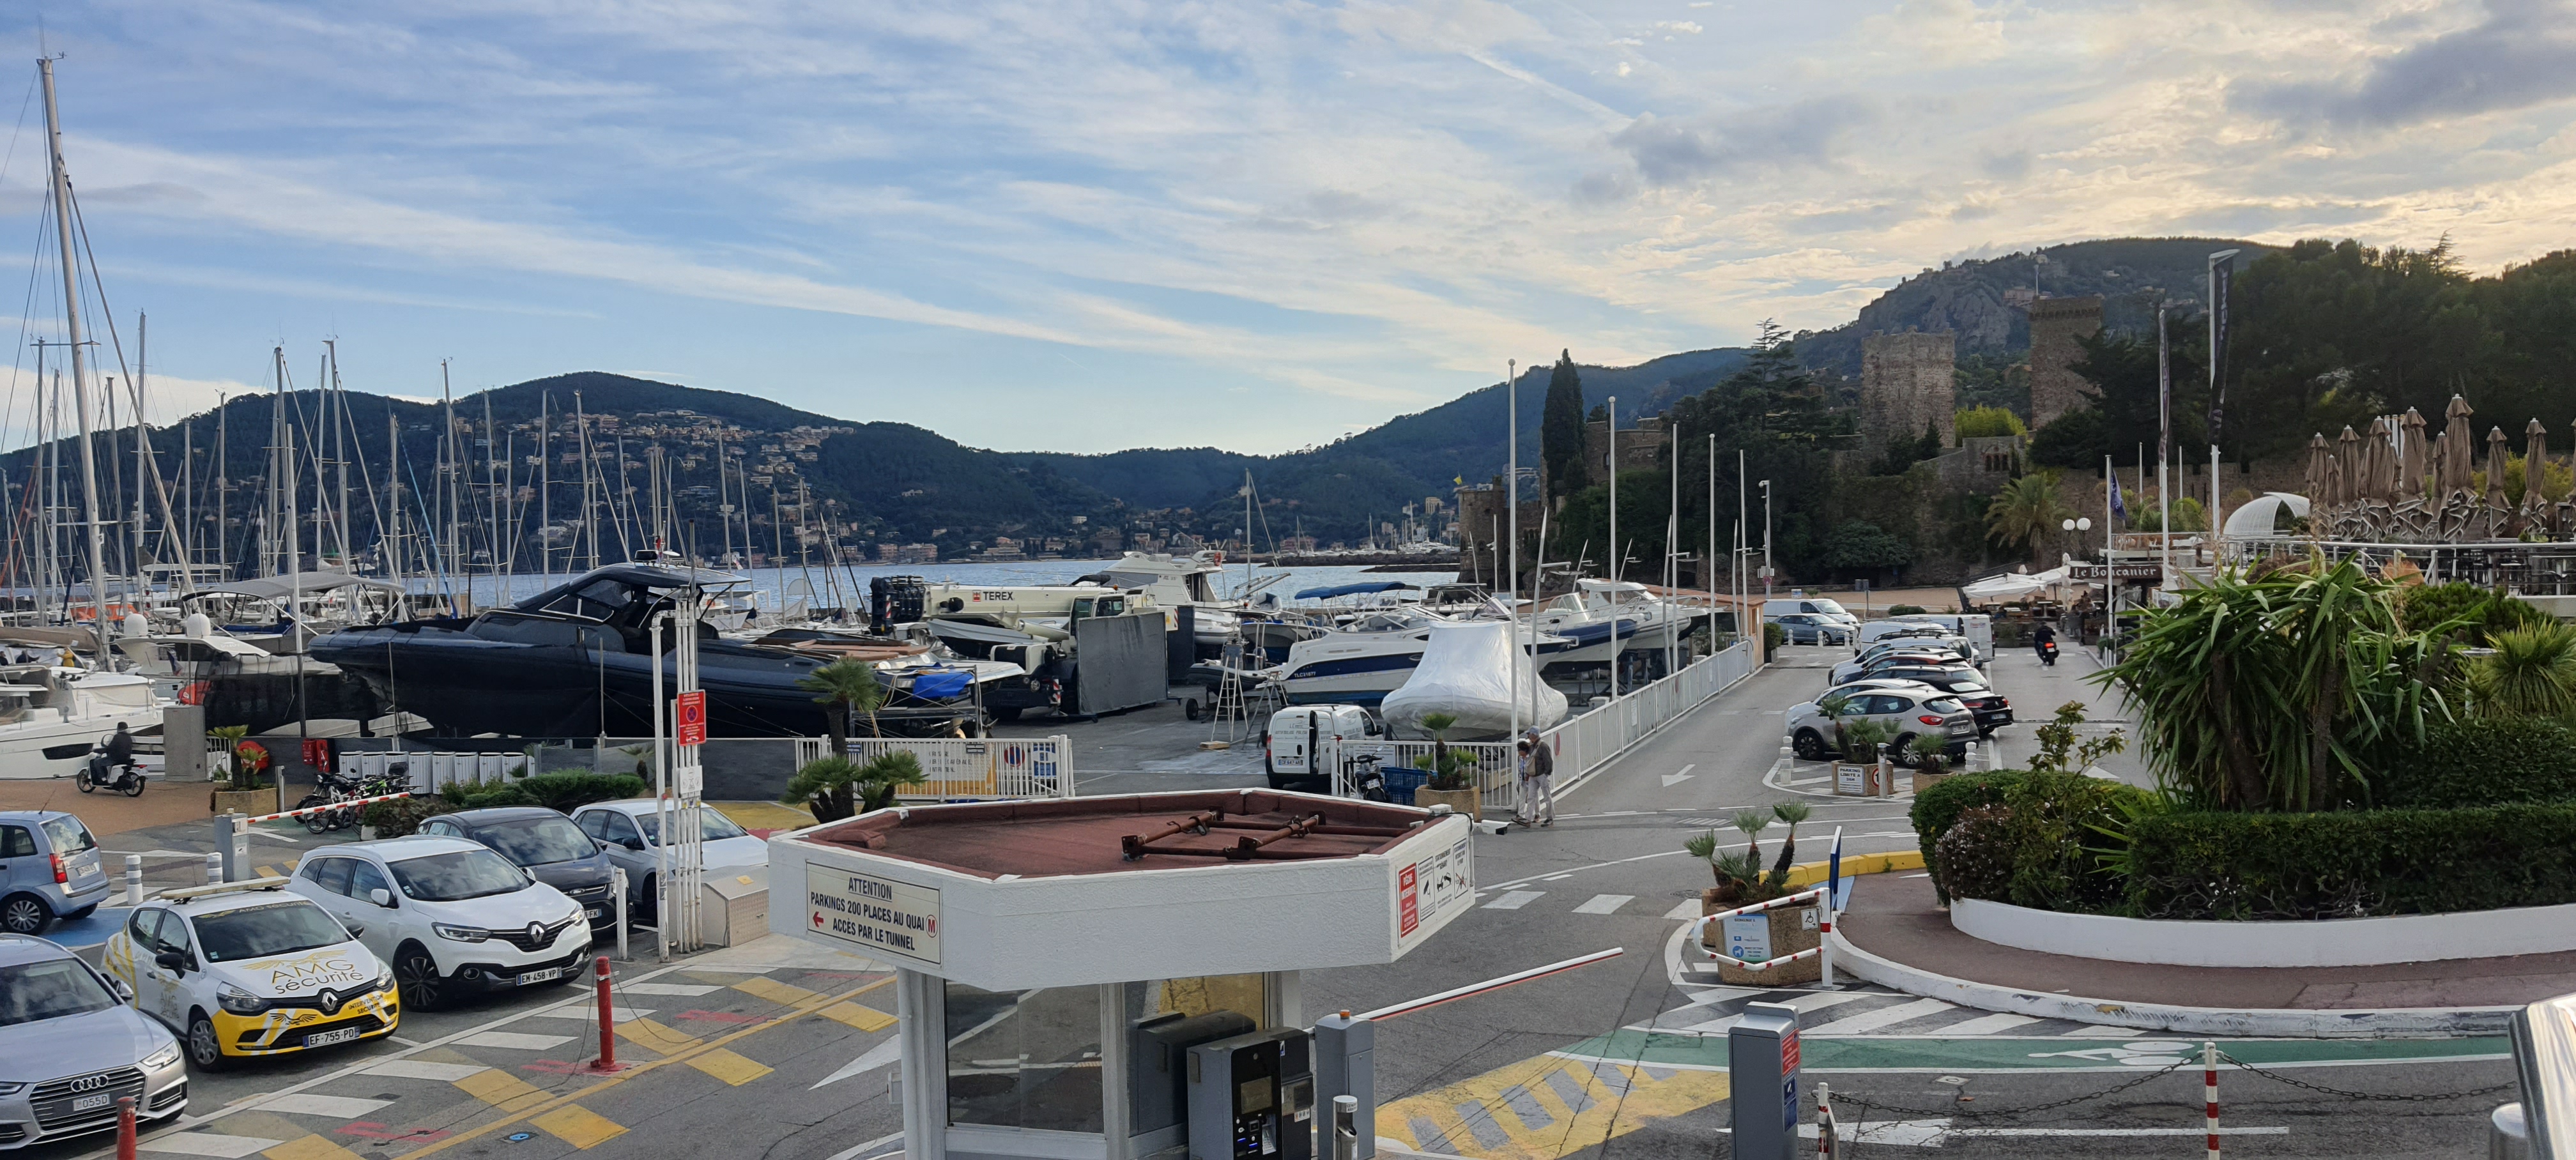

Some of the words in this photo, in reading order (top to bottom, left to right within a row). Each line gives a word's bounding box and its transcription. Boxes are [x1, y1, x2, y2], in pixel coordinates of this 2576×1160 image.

[983, 591, 1013, 600] TEREX
[848, 877, 893, 900] ATTENTION
[811, 892, 845, 912] PARKINGS
[847, 901, 861, 915] 200
[864, 904, 891, 923] PLACES
[893, 911, 904, 926] AU
[906, 915, 924, 931] QUAI
[832, 917, 856, 936] ACCÈS
[858, 924, 873, 940] PAR
[875, 929, 884, 943] LE
[885, 931, 916, 950] TUNNEL
[272, 959, 353, 984] AMG
[275, 970, 364, 995] sécurité
[348, 993, 383, 1010] INTERVENTION
[309, 1028, 354, 1045] EF-755-PD
